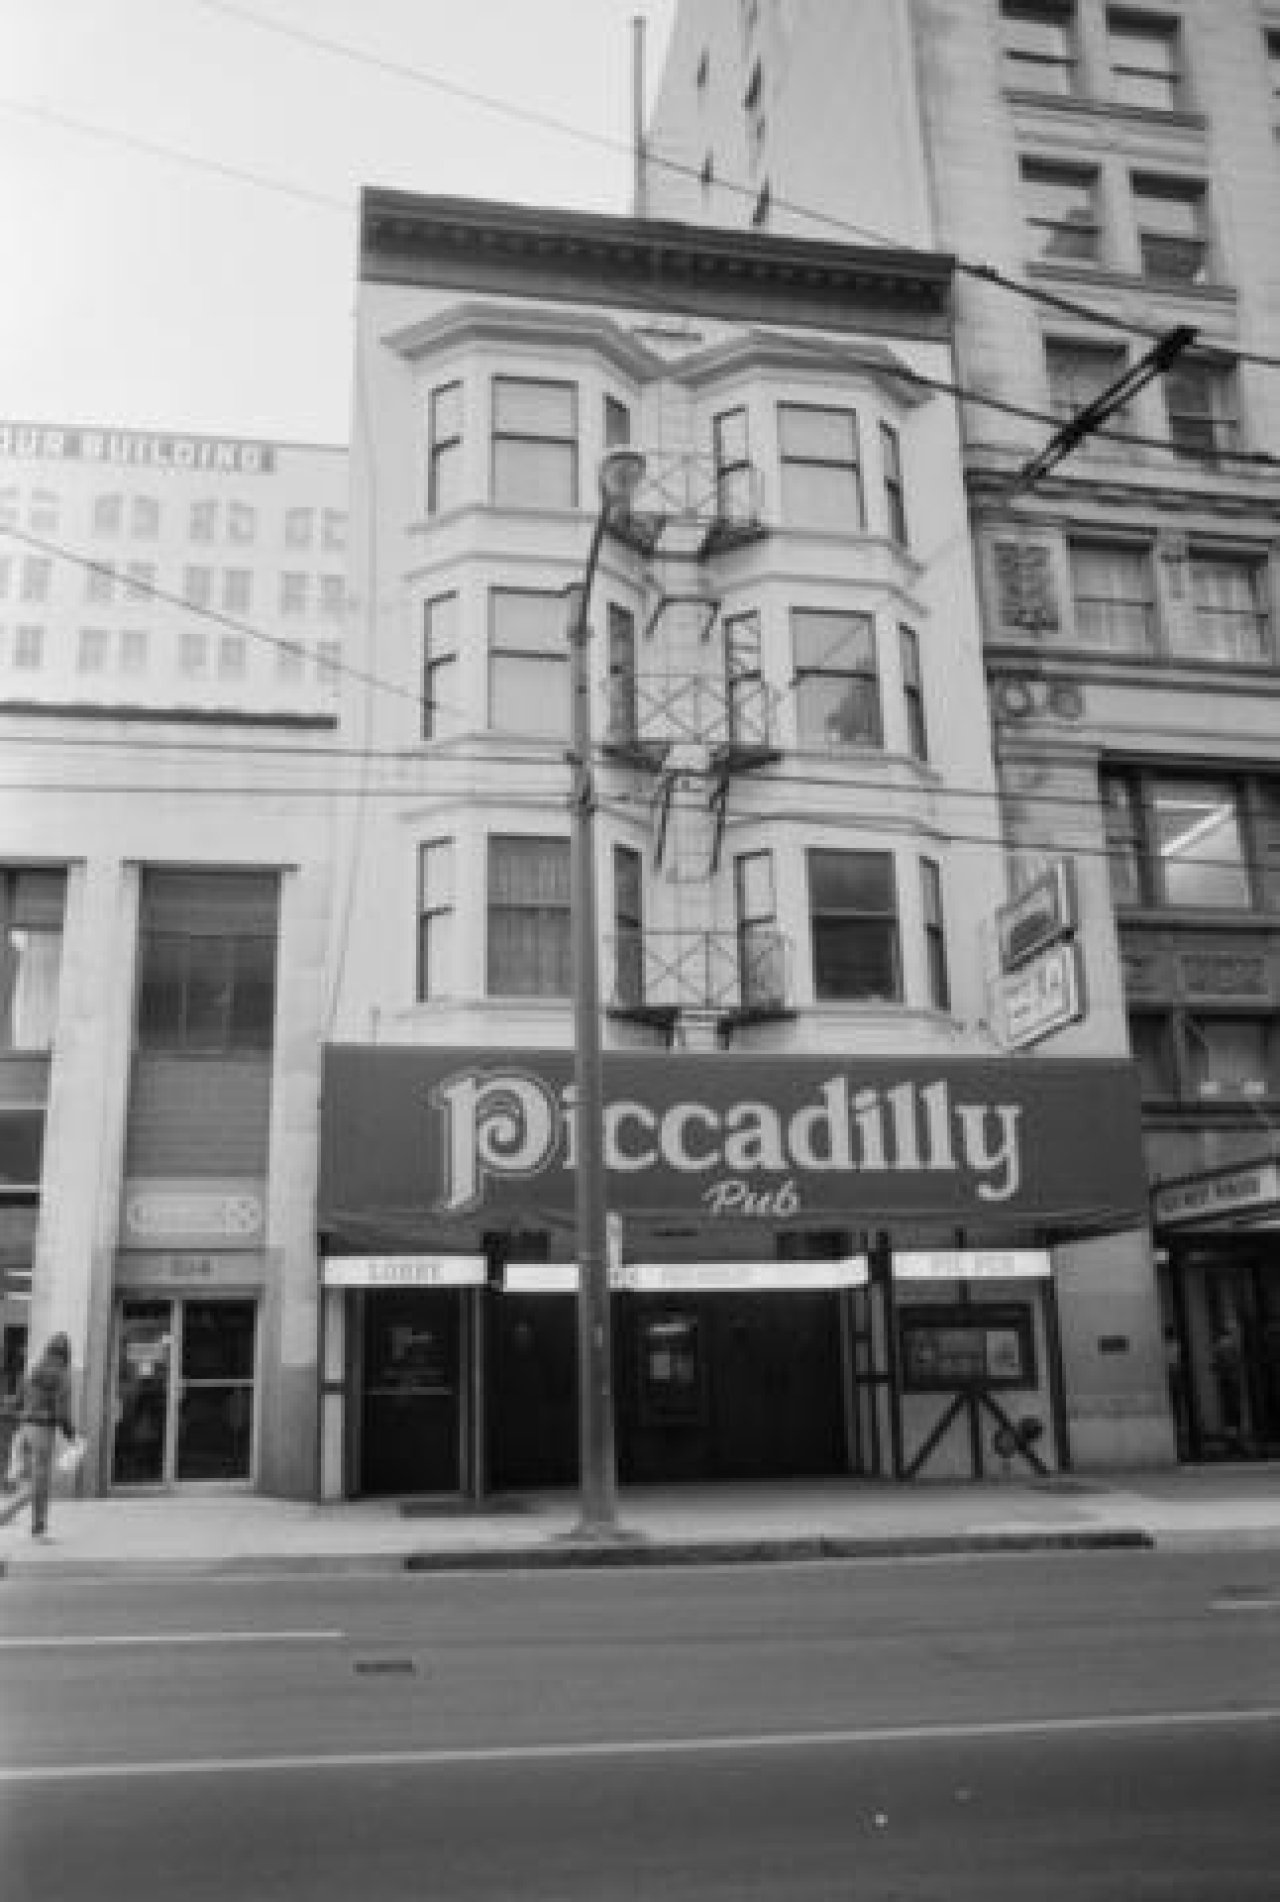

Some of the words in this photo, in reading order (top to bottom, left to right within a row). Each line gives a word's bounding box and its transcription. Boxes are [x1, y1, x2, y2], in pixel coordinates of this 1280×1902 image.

[82, 431, 260, 472] BUILDING
[436, 1072, 1023, 1210] Piccadilly
[702, 1179, 799, 1216] Pub
